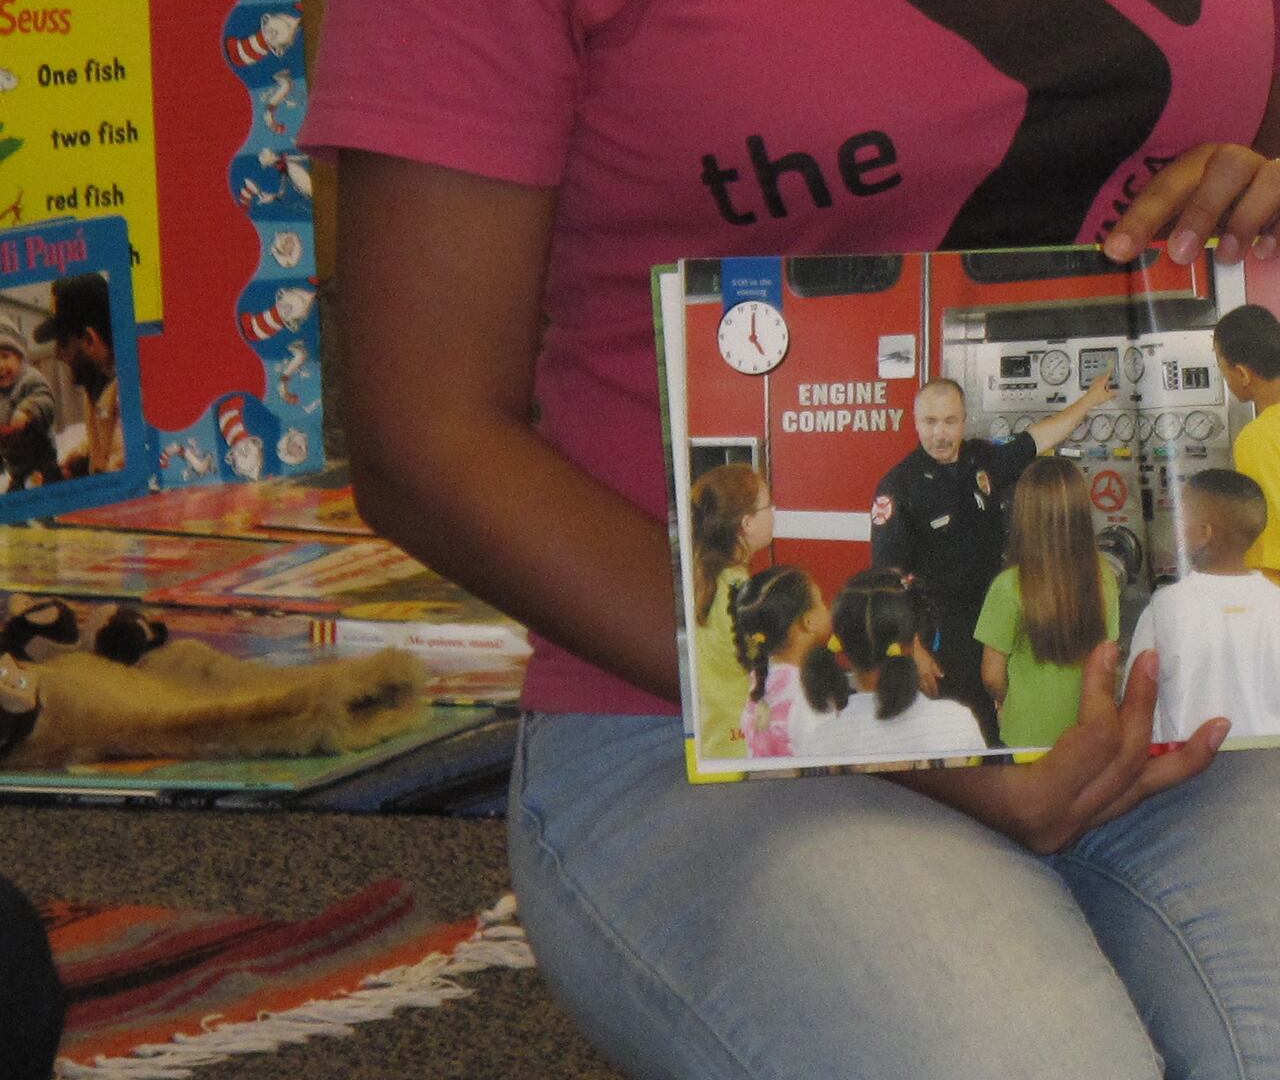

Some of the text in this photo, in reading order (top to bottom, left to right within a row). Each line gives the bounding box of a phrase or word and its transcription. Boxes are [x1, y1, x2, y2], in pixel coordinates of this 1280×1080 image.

[37, 57, 126, 88] One fish
[51, 119, 139, 150] two fish
[700, 128, 903, 227] the
[46, 182, 125, 212] red fish
[798, 381, 889, 406] ENGINE
[781, 408, 904, 433] COMPANY
